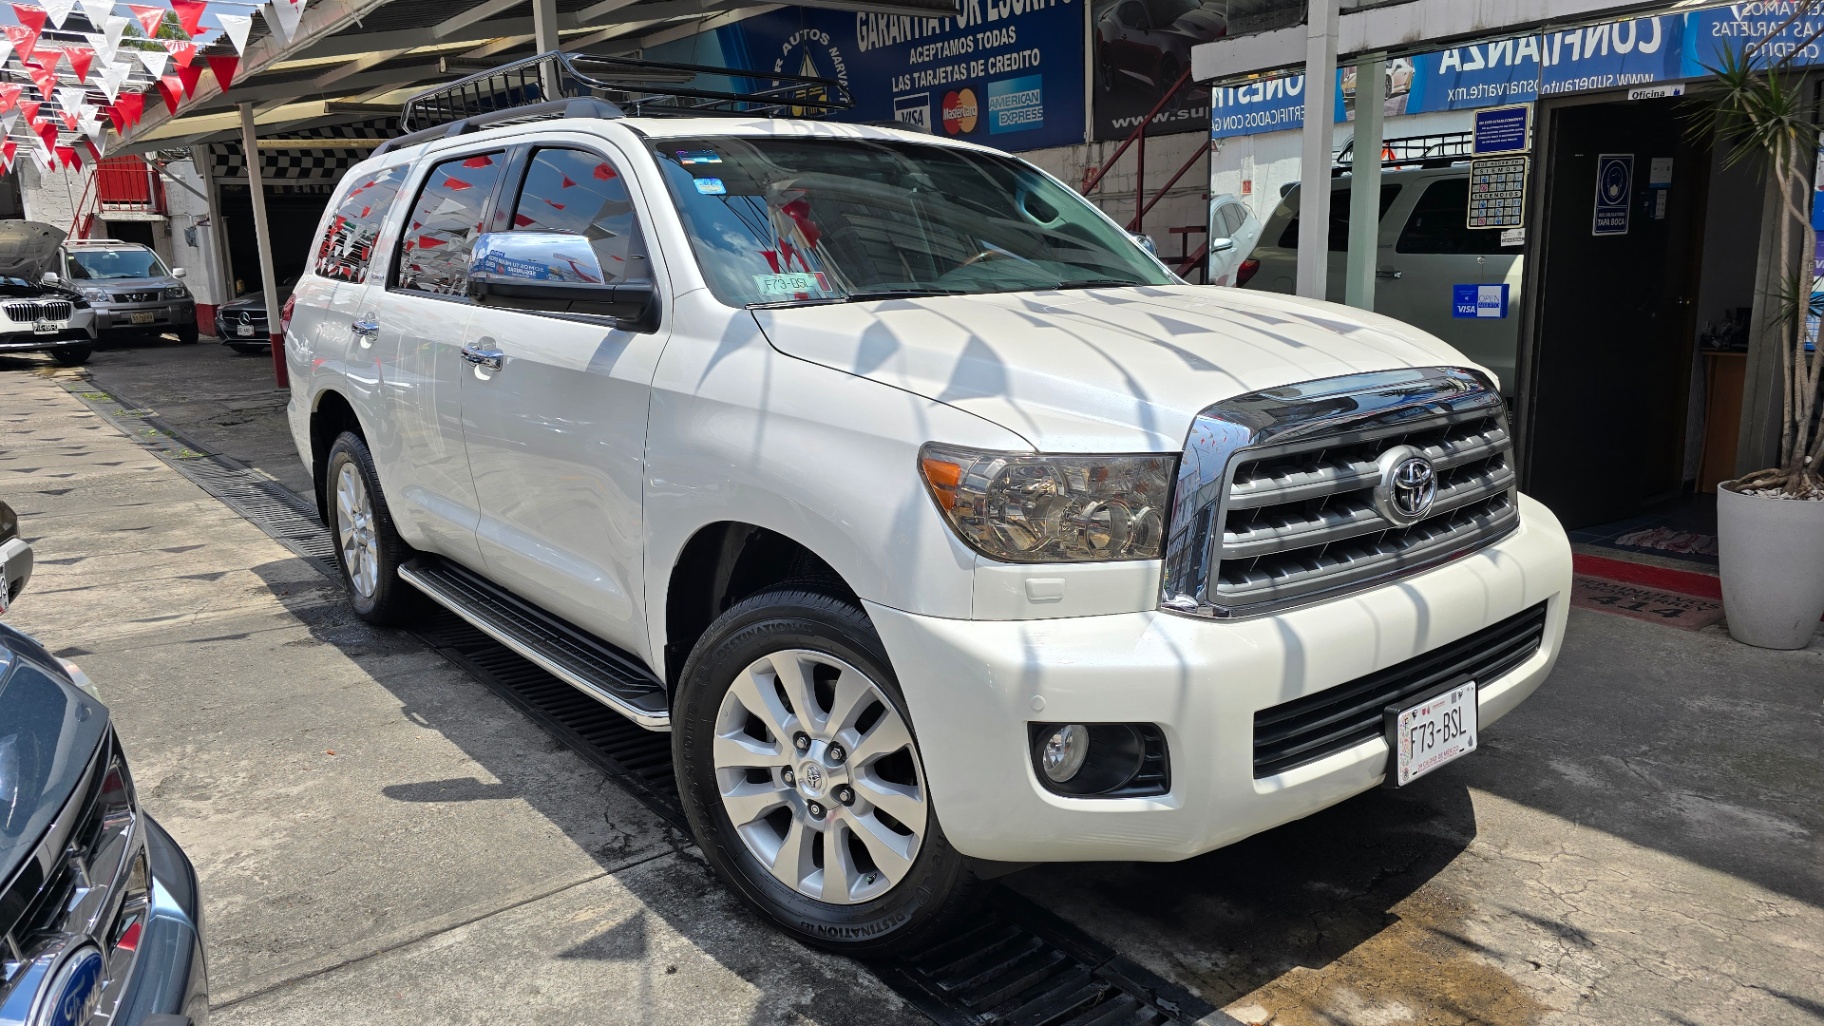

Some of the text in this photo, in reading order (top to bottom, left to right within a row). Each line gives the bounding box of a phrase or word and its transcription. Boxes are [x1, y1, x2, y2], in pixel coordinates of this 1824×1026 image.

[783, 29, 829, 56] AUTOS
[909, 25, 1016, 65] ACEPTAMOS TODAS
[892, 48, 1040, 92] LAS TARJETAS DE CREDITO
[989, 89, 1039, 109] AMERICAN
[1632, 90, 1665, 100] Oficina
[901, 109, 924, 126] VISA
[943, 105, 977, 120] MasterCard
[1000, 107, 1043, 125] EXPRESS
[1480, 166, 1517, 174] SISMOS
[1457, 305, 1476, 314] VISA
[1410, 705, 1467, 760] F73-BSL
[818, 912, 906, 938] DESTINATION
